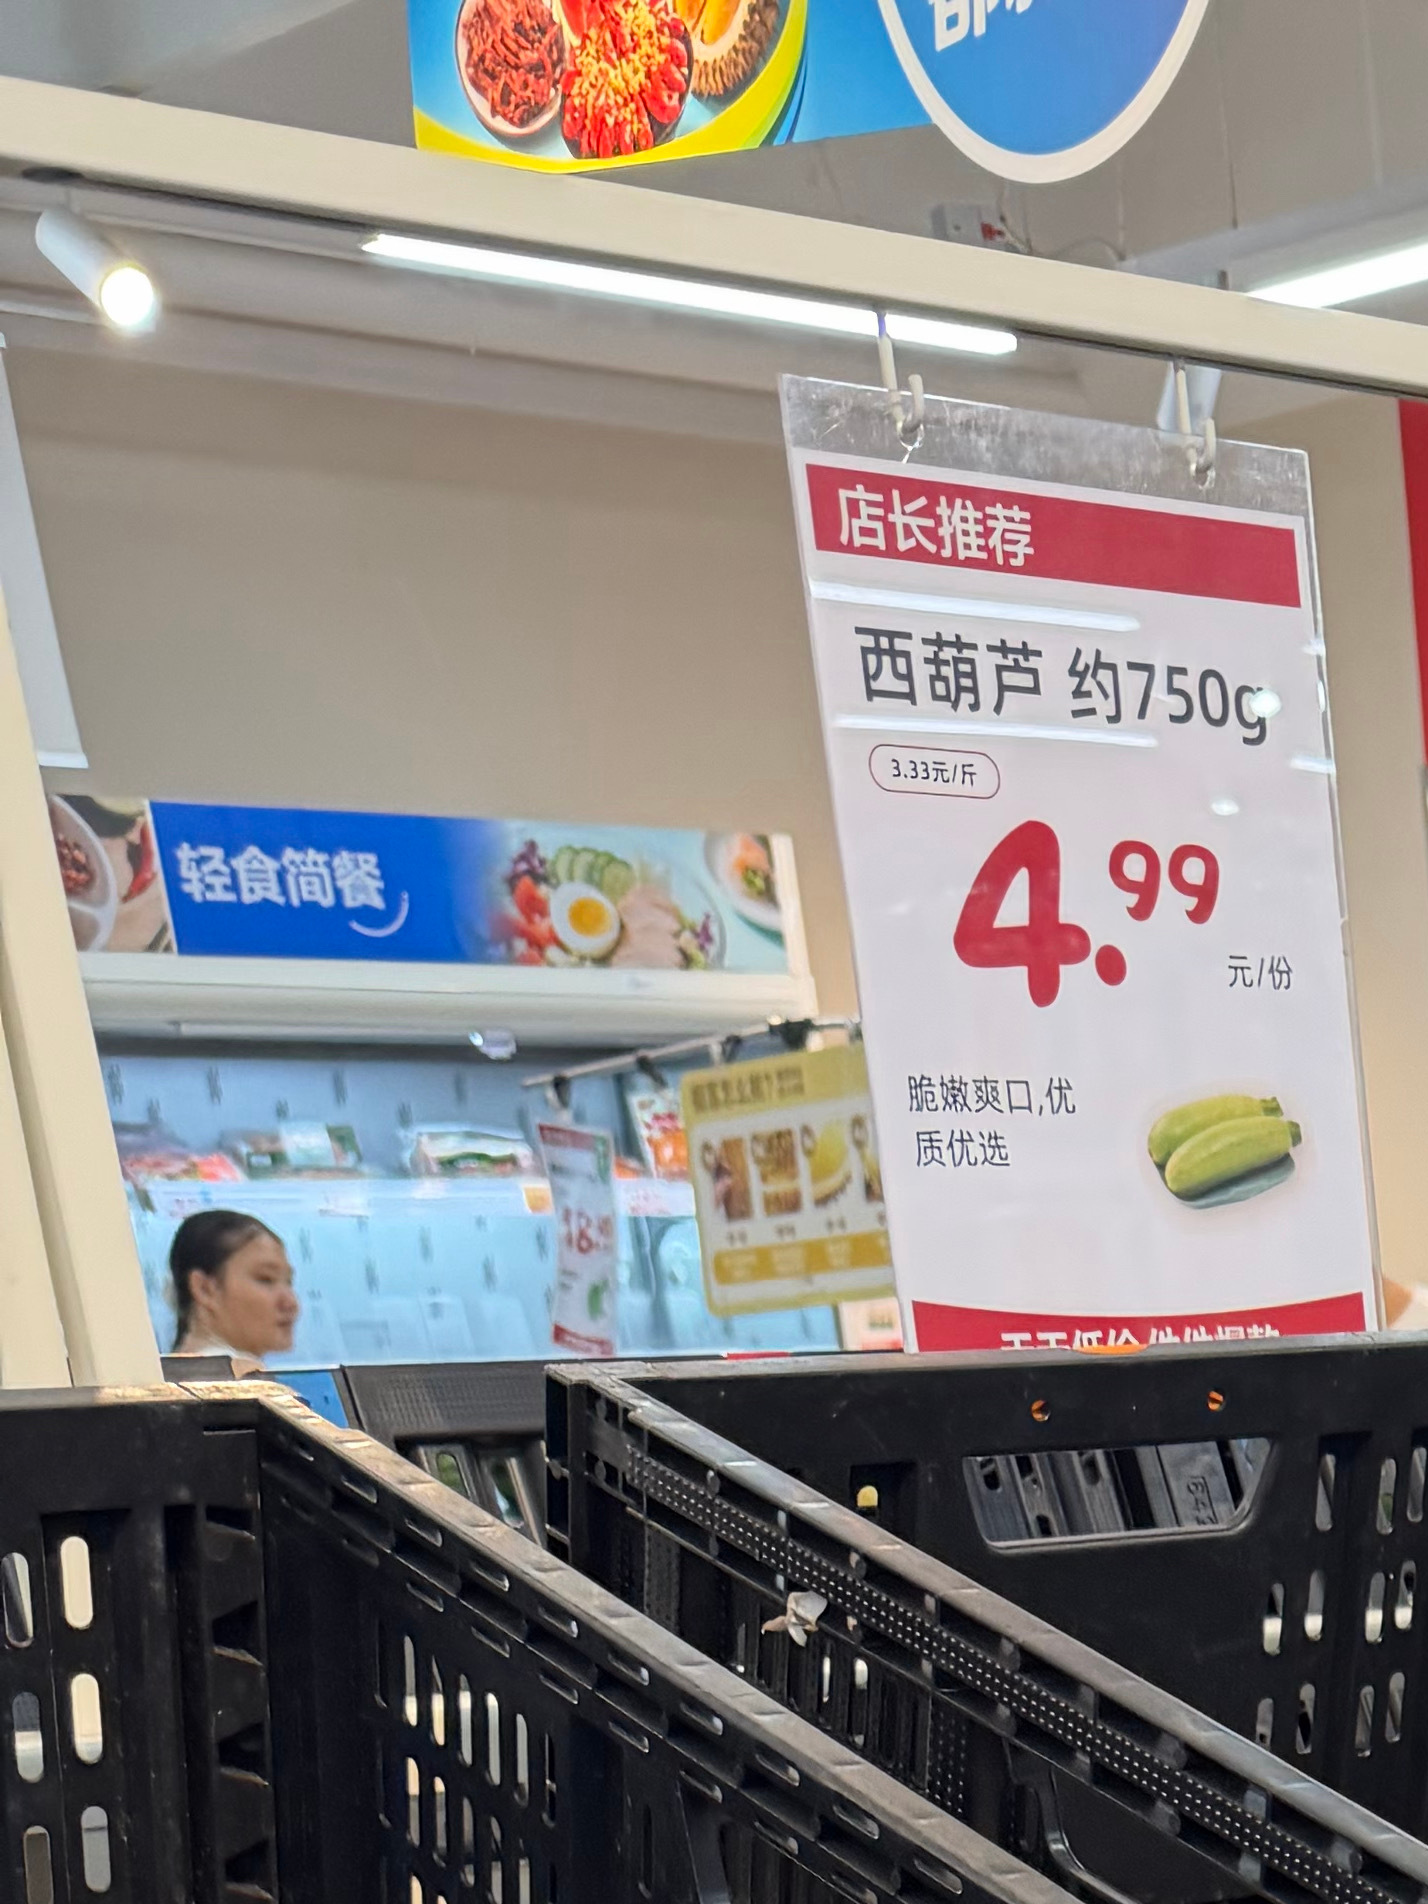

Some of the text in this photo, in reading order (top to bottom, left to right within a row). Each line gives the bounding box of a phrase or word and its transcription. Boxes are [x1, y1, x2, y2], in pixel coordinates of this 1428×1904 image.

[837, 483, 1035, 568] 店长推荐
[854, 625, 1270, 746] 西葫芦 约750g
[891, 758, 977, 787] 3.33元/斤
[174, 842, 387, 911] 轻食简餐
[953, 820, 1221, 1008] 4.99
[1227, 954, 1292, 990] 元/份
[915, 1130, 1011, 1168] 质优选
